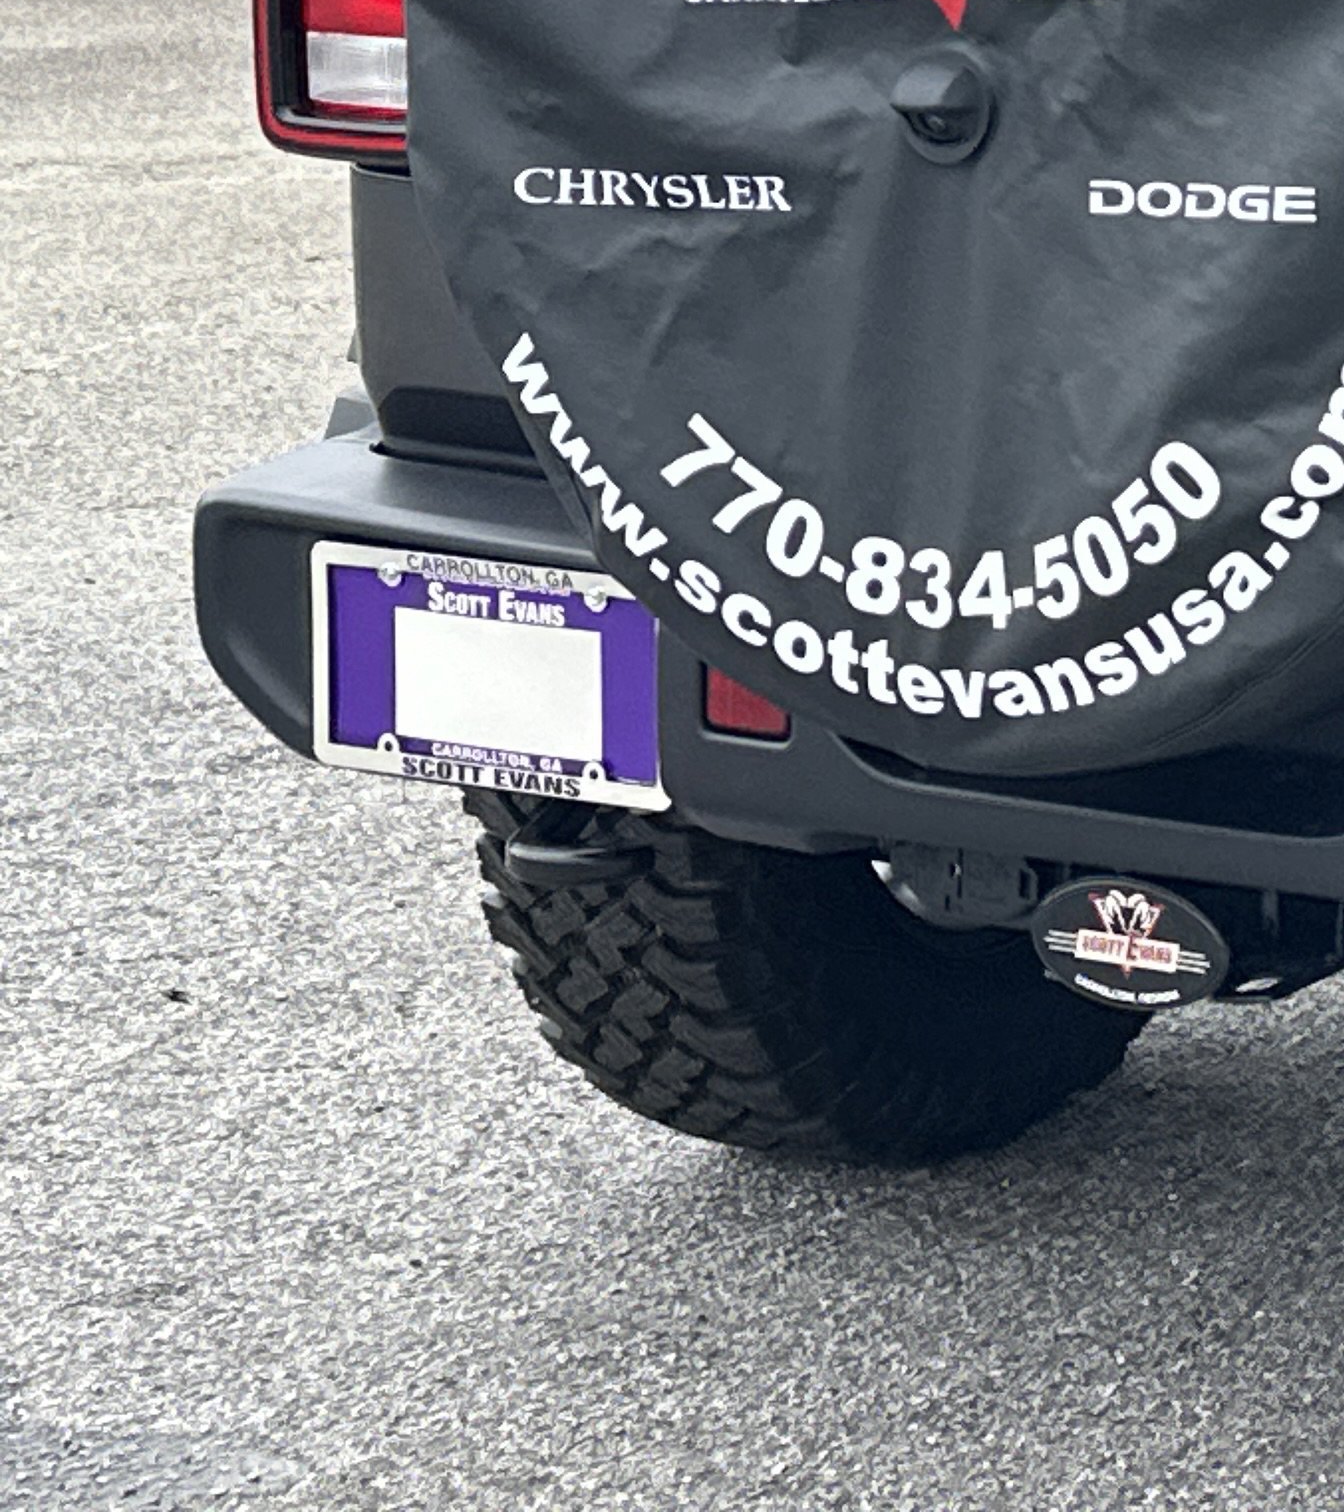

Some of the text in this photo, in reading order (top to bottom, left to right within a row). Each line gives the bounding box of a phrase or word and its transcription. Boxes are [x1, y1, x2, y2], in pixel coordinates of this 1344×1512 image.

[513, 166, 792, 213] CHRYSLER
[1088, 179, 1318, 223] DODGE
[659, 412, 1221, 630] 770-834-5050
[545, 569, 574, 589] GA
[427, 580, 566, 627] SCOTT EVANS
[401, 756, 582, 798] SCOTT EVANS
[539, 757, 563, 774] GA
